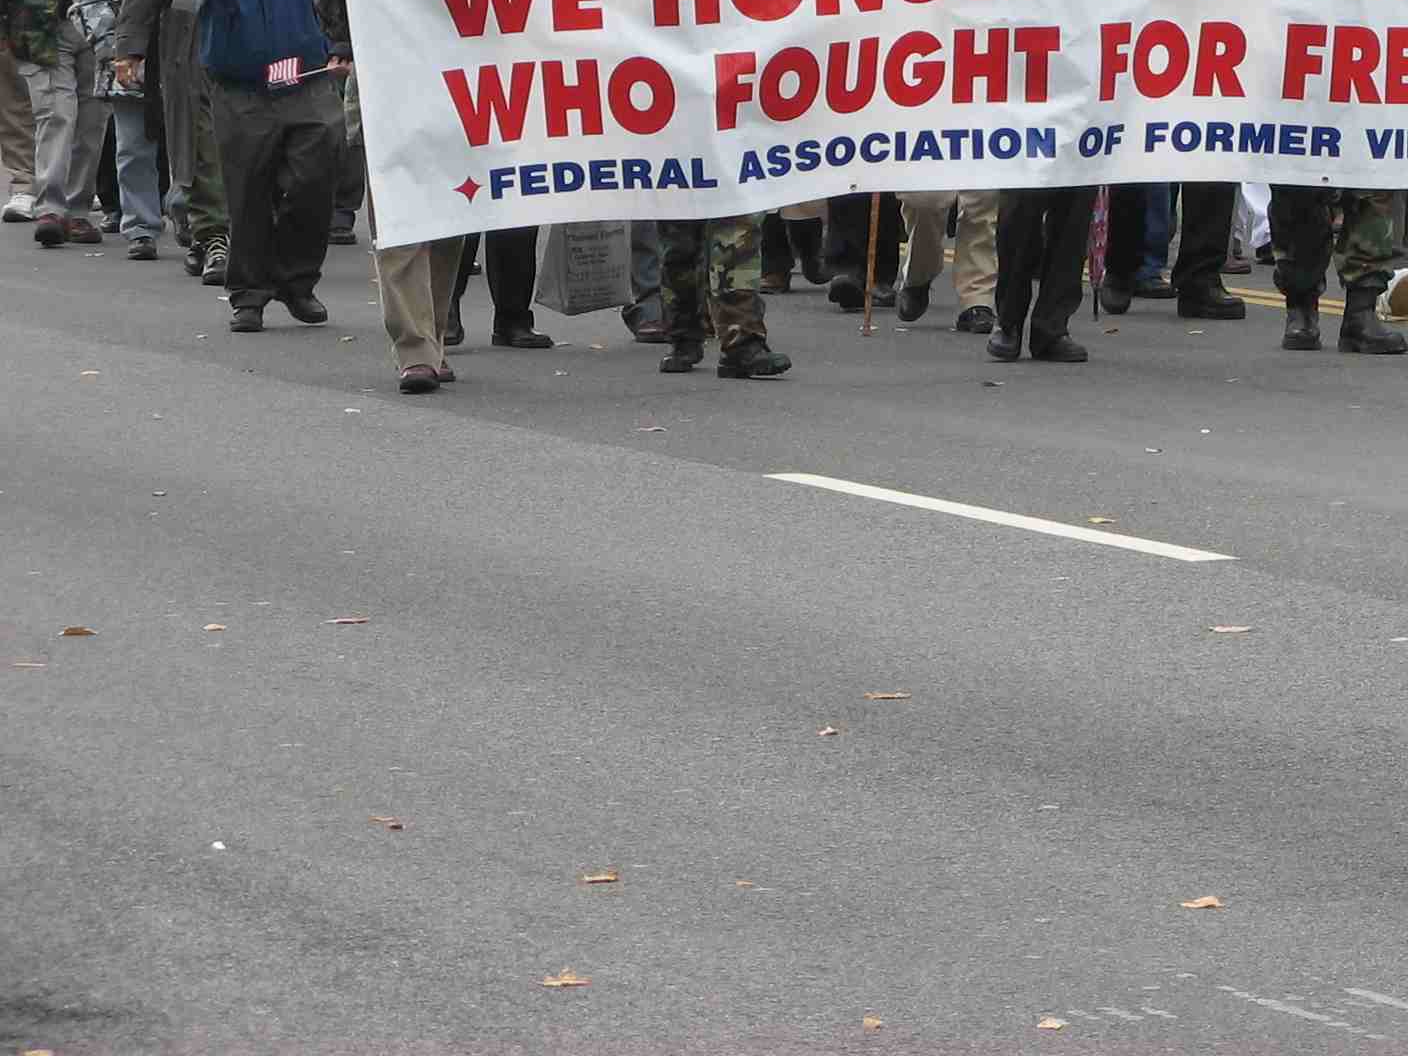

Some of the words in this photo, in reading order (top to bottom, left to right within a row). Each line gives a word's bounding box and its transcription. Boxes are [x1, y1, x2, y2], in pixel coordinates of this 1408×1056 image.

[442, 51, 677, 146] WHO
[715, 25, 1061, 132] FOUGHT
[1099, 19, 1248, 101] FOR
[489, 156, 719, 200] FEDERAL
[739, 126, 1057, 183] ASSOCIATION
[1078, 124, 1125, 158] OF
[1144, 120, 1342, 158] FORMER
